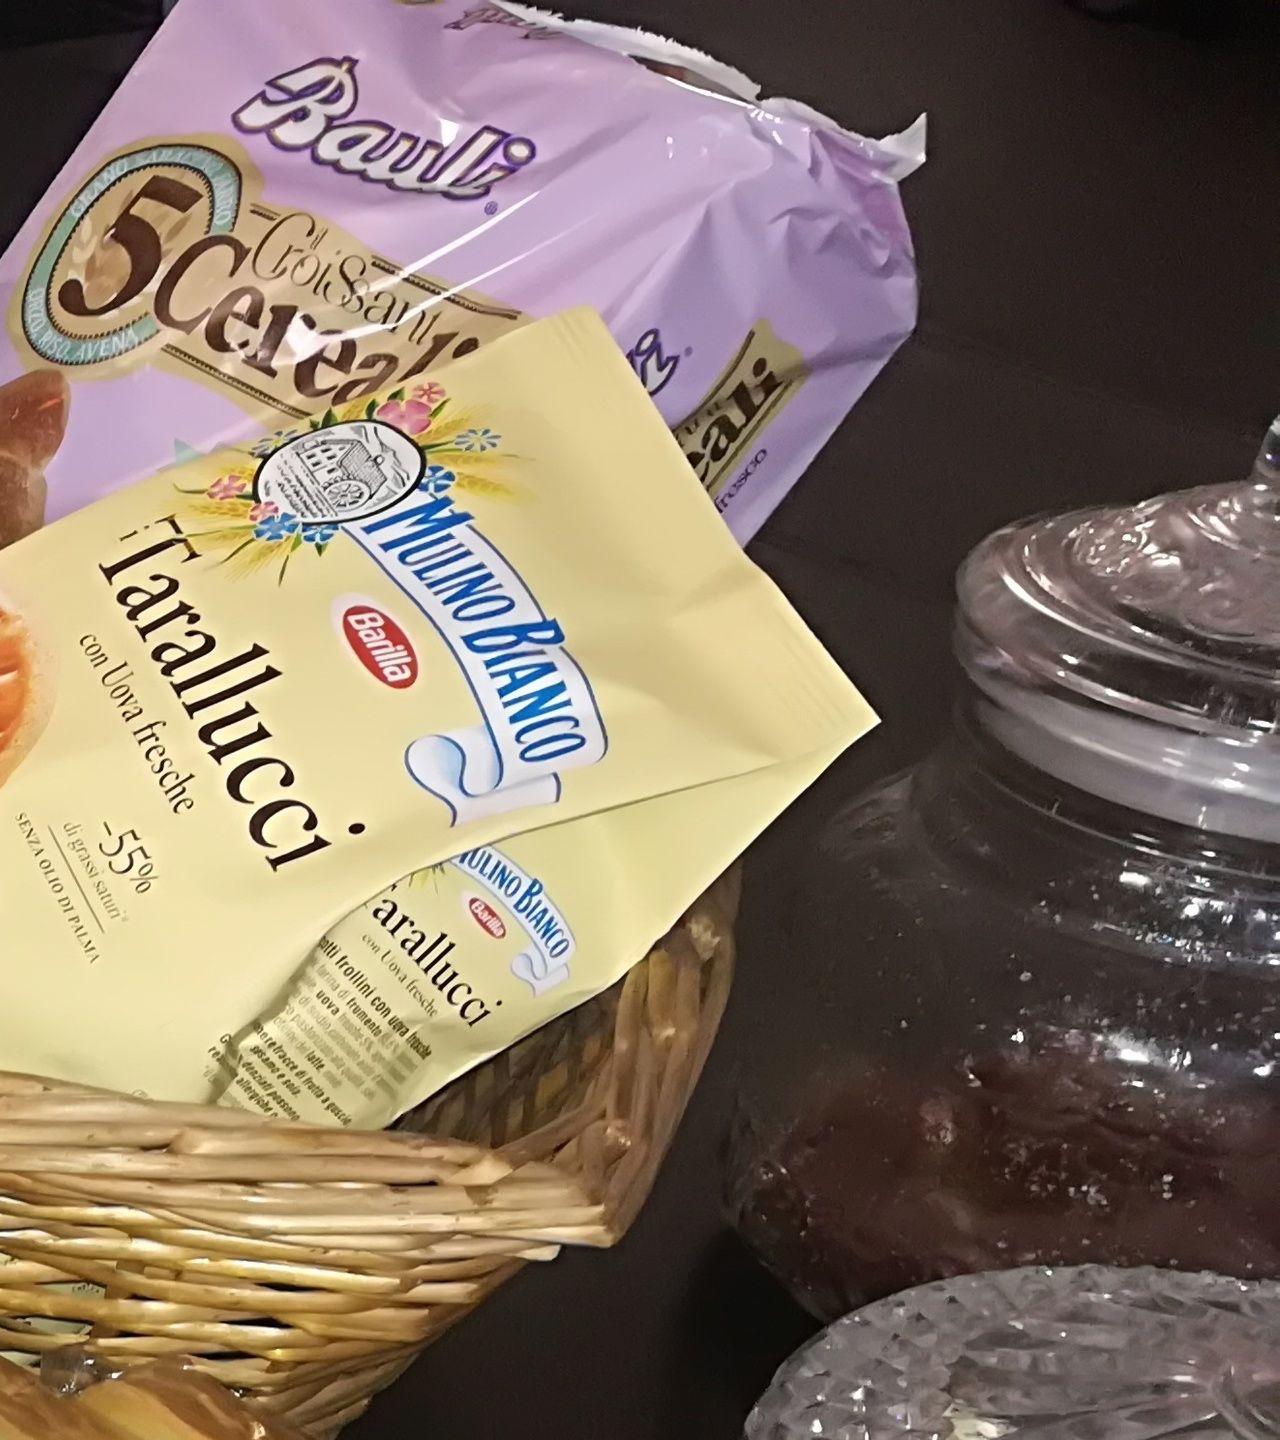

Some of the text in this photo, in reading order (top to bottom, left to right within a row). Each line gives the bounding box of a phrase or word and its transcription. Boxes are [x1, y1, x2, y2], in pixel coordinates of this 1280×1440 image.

[231, 56, 536, 200] Bauli
[58, 175, 205, 317] 5
[153, 233, 480, 407] Cereal
[251, 213, 439, 342] Croissant
[347, 612, 411, 683] Barilla
[360, 495, 586, 763] MULINO BIANCO
[80, 633, 195, 815] con Uova fresche
[100, 516, 368, 873] Tarallucci
[14, 811, 101, 964] SENZA OLIO DI PALMA
[67, 837, 98, 878] grassi
[98, 820, 159, 895] -55%
[362, 932, 380, 954] con
[470, 899, 504, 938] Barilla
[515, 878, 570, 959] BIANCO
[335, 949, 372, 1000] frollini
[370, 991, 391, 1020] con
[372, 894, 502, 1027] arallucci
[316, 990, 340, 1016] uova
[346, 995, 382, 1037] frumento
